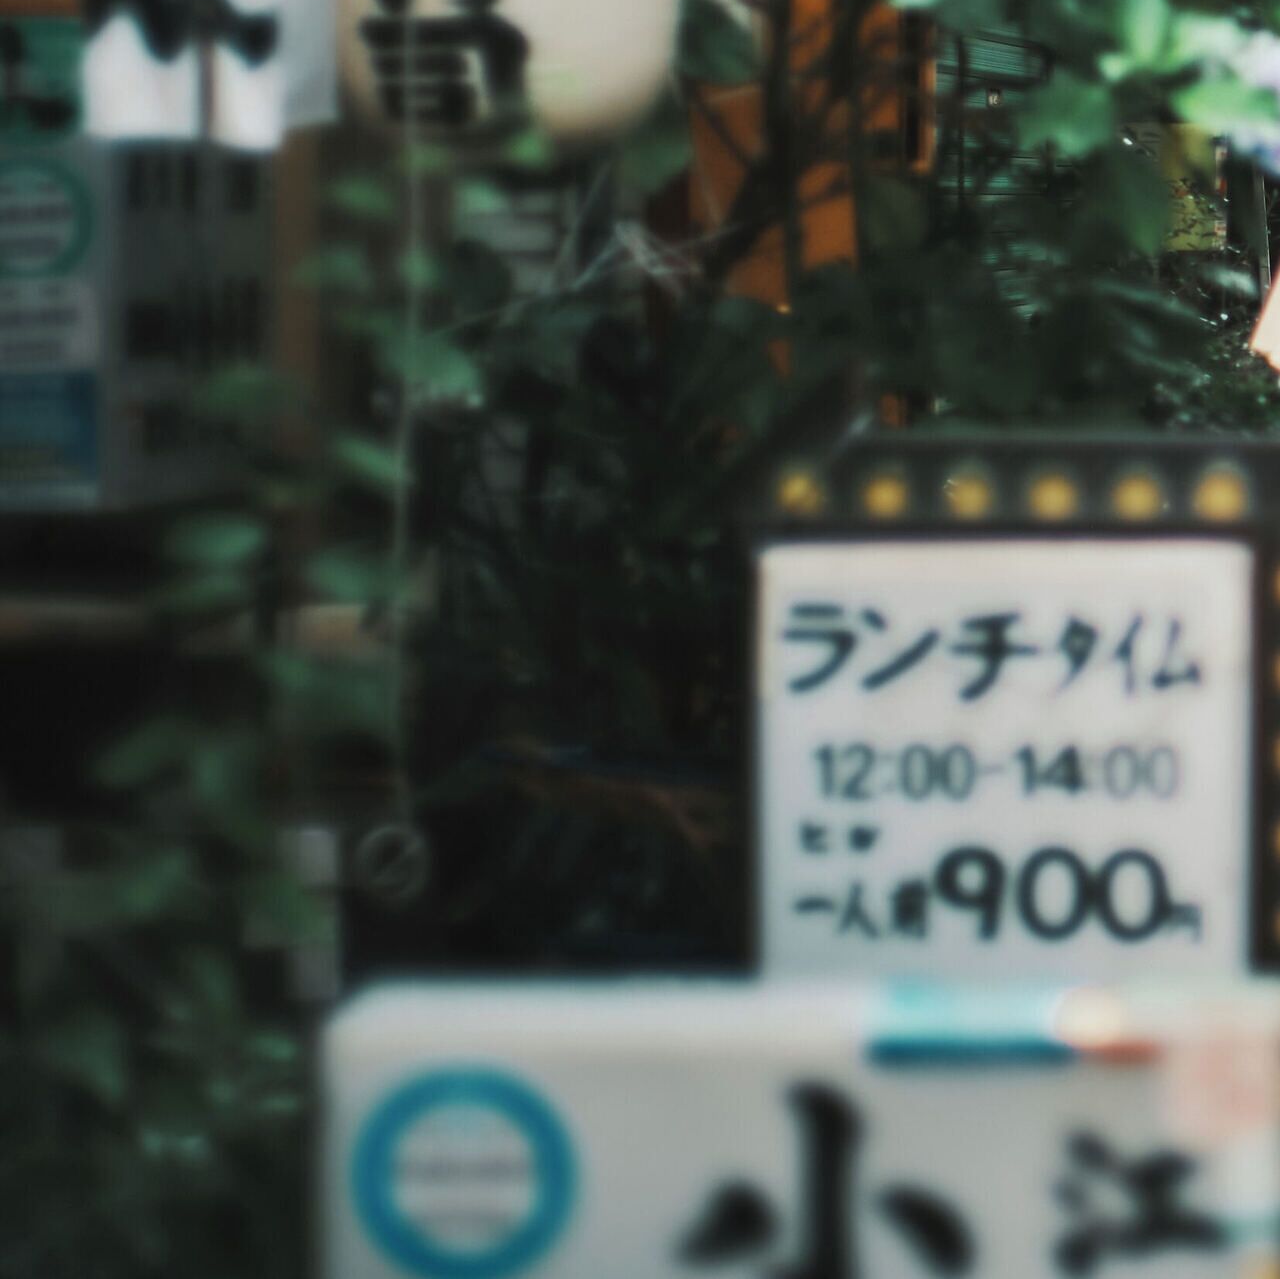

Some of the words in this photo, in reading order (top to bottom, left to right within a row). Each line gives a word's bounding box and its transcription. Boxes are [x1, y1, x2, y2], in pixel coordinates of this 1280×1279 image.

[782, 602, 1204, 703] ランチタイム
